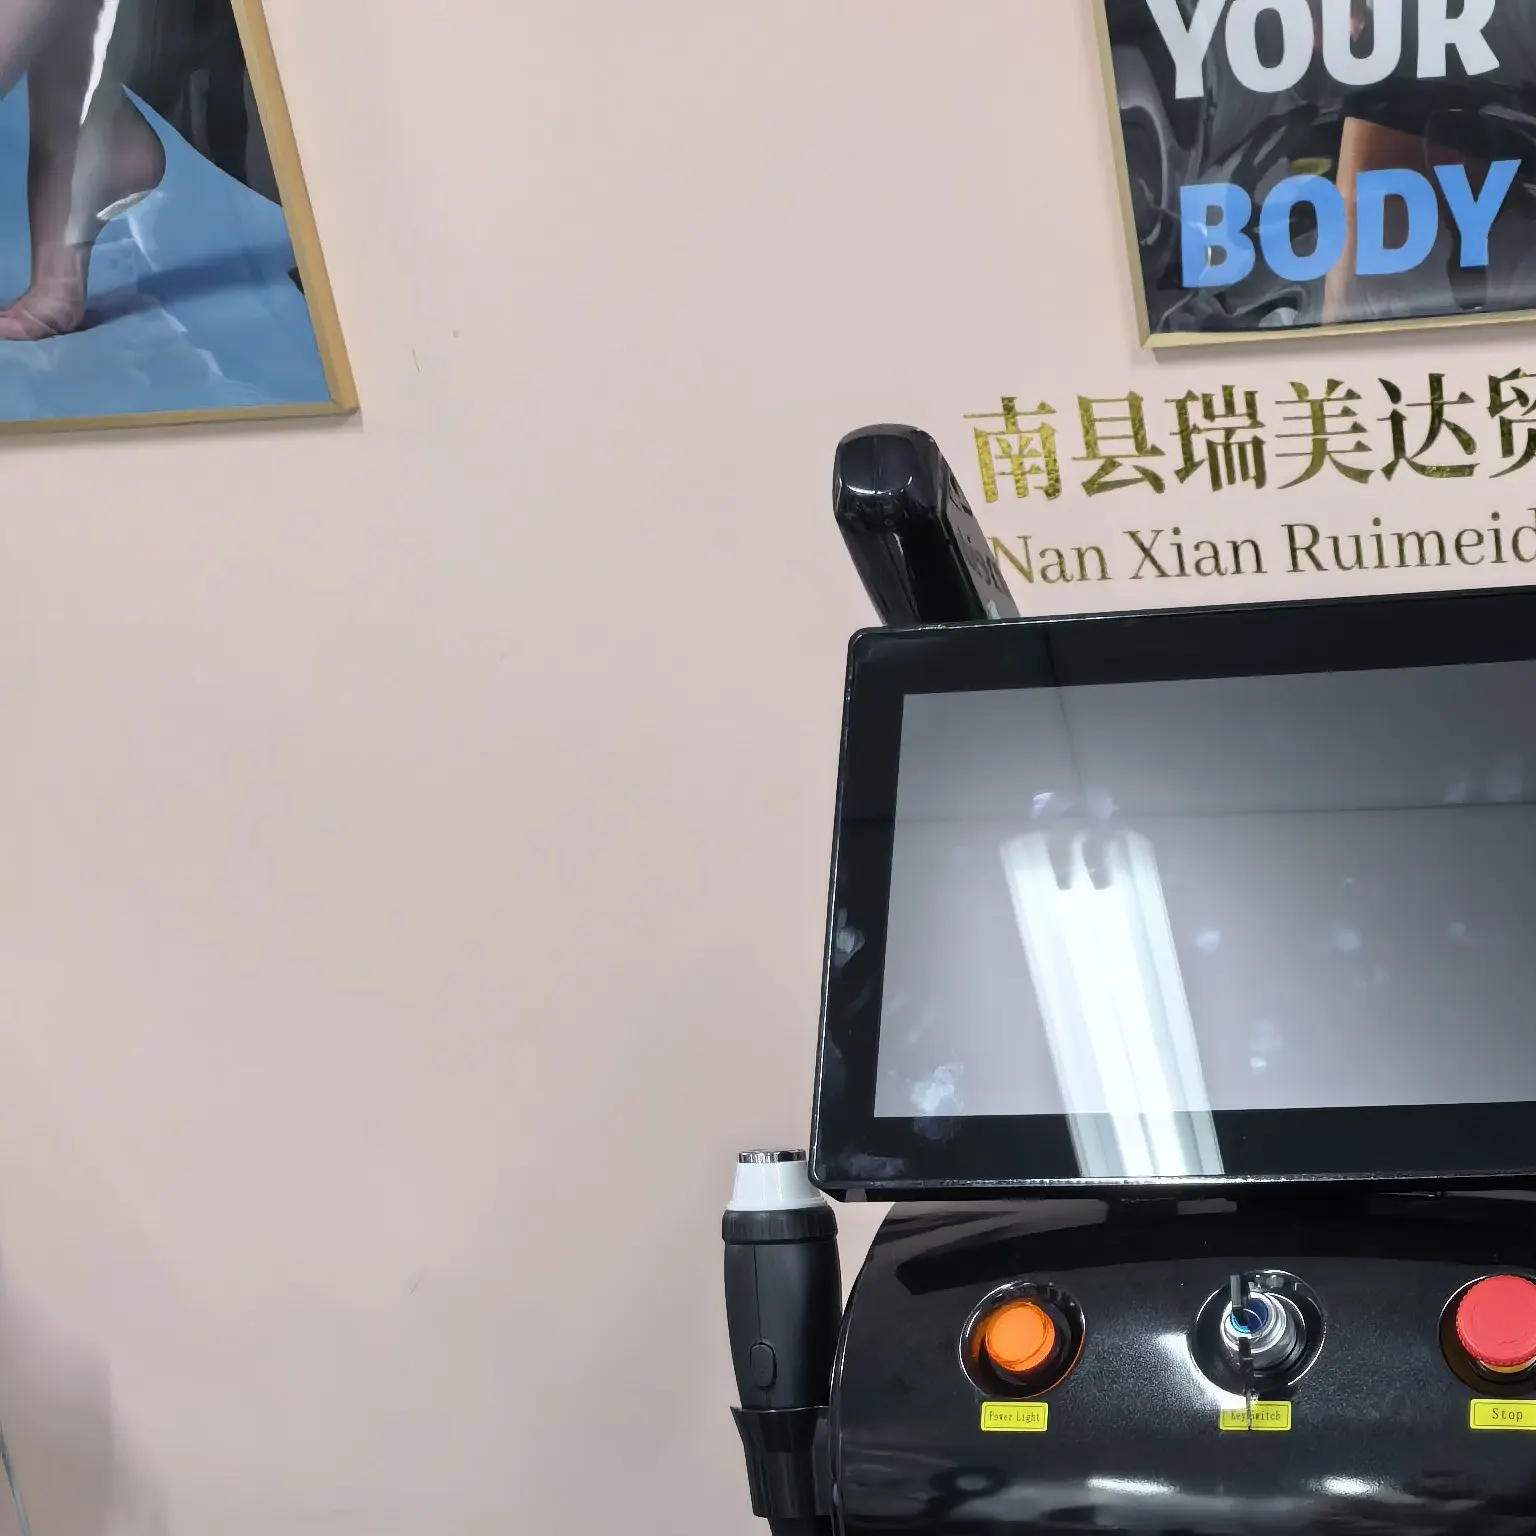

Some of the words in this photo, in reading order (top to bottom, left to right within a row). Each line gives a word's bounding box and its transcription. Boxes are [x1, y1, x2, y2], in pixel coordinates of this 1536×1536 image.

[1145, 0, 1500, 99] YOUR
[1180, 159, 1521, 288] BODY
[987, 535, 1111, 584] Nan
[1123, 527, 1268, 580] Xian
[989, 1410, 1012, 1422] Power
[1016, 1410, 1039, 1424] Light
[1491, 1407, 1523, 1422] Stop
